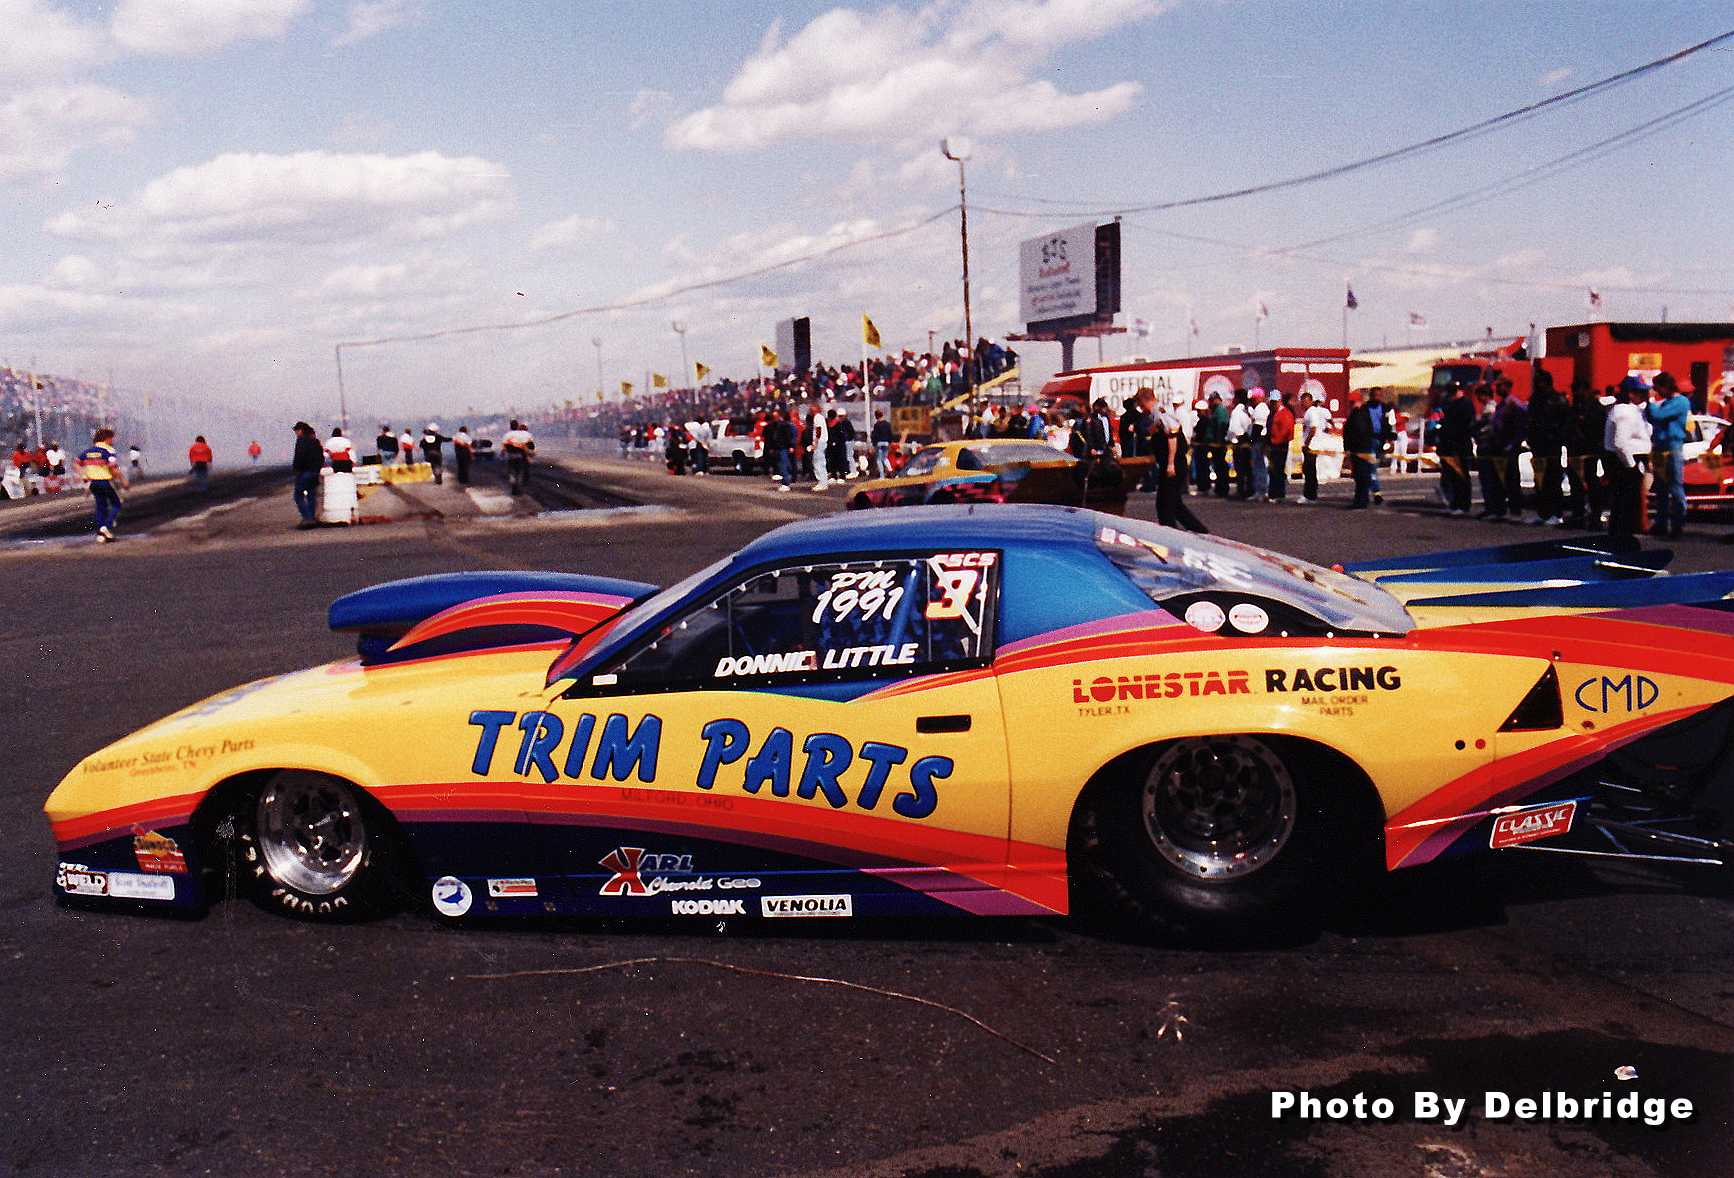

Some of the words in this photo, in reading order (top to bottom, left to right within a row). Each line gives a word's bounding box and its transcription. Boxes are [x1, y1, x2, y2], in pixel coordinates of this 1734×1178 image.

[831, 570, 897, 592] PM
[812, 587, 905, 624] 1991
[822, 643, 919, 669] LITTLE
[1073, 670, 1249, 703] LONESTAR
[1265, 665, 1401, 693] RACING
[1574, 674, 1659, 713] CMD
[1319, 706, 1354, 716] PARTS
[468, 710, 663, 784] TRIM
[696, 718, 954, 818] PARTS
[671, 899, 747, 915] KODIAK
[766, 898, 848, 913] VENOLIA
